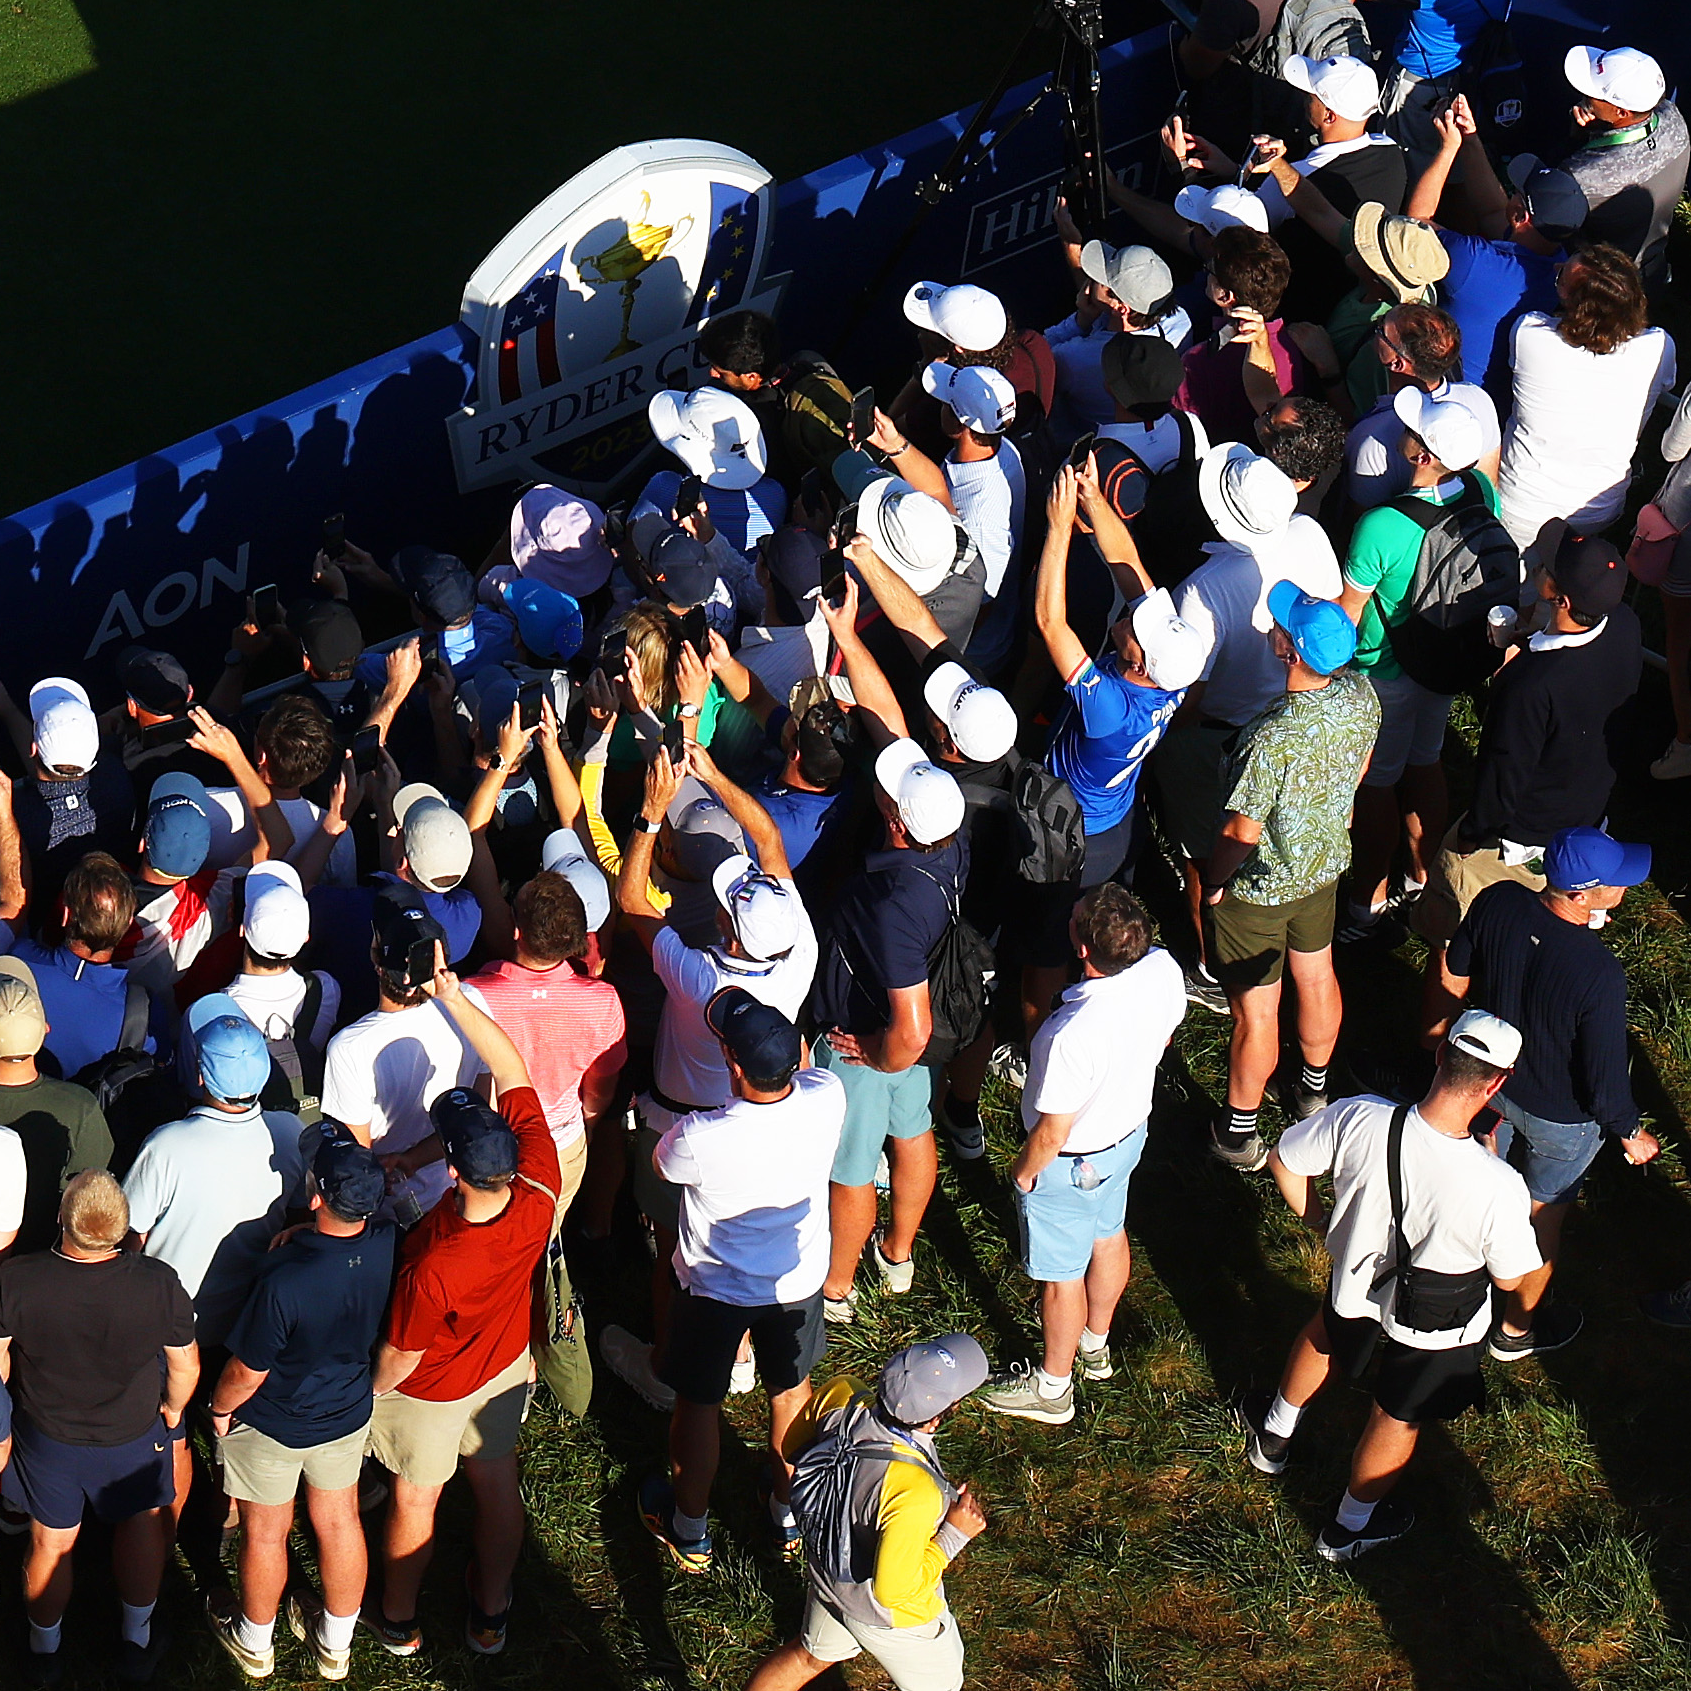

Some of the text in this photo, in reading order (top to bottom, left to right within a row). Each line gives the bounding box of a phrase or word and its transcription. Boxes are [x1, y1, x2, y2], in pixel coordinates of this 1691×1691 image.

[981, 158, 1144, 253] Hiln
[475, 364, 641, 467] RYDER
[82, 541, 251, 661] AON
